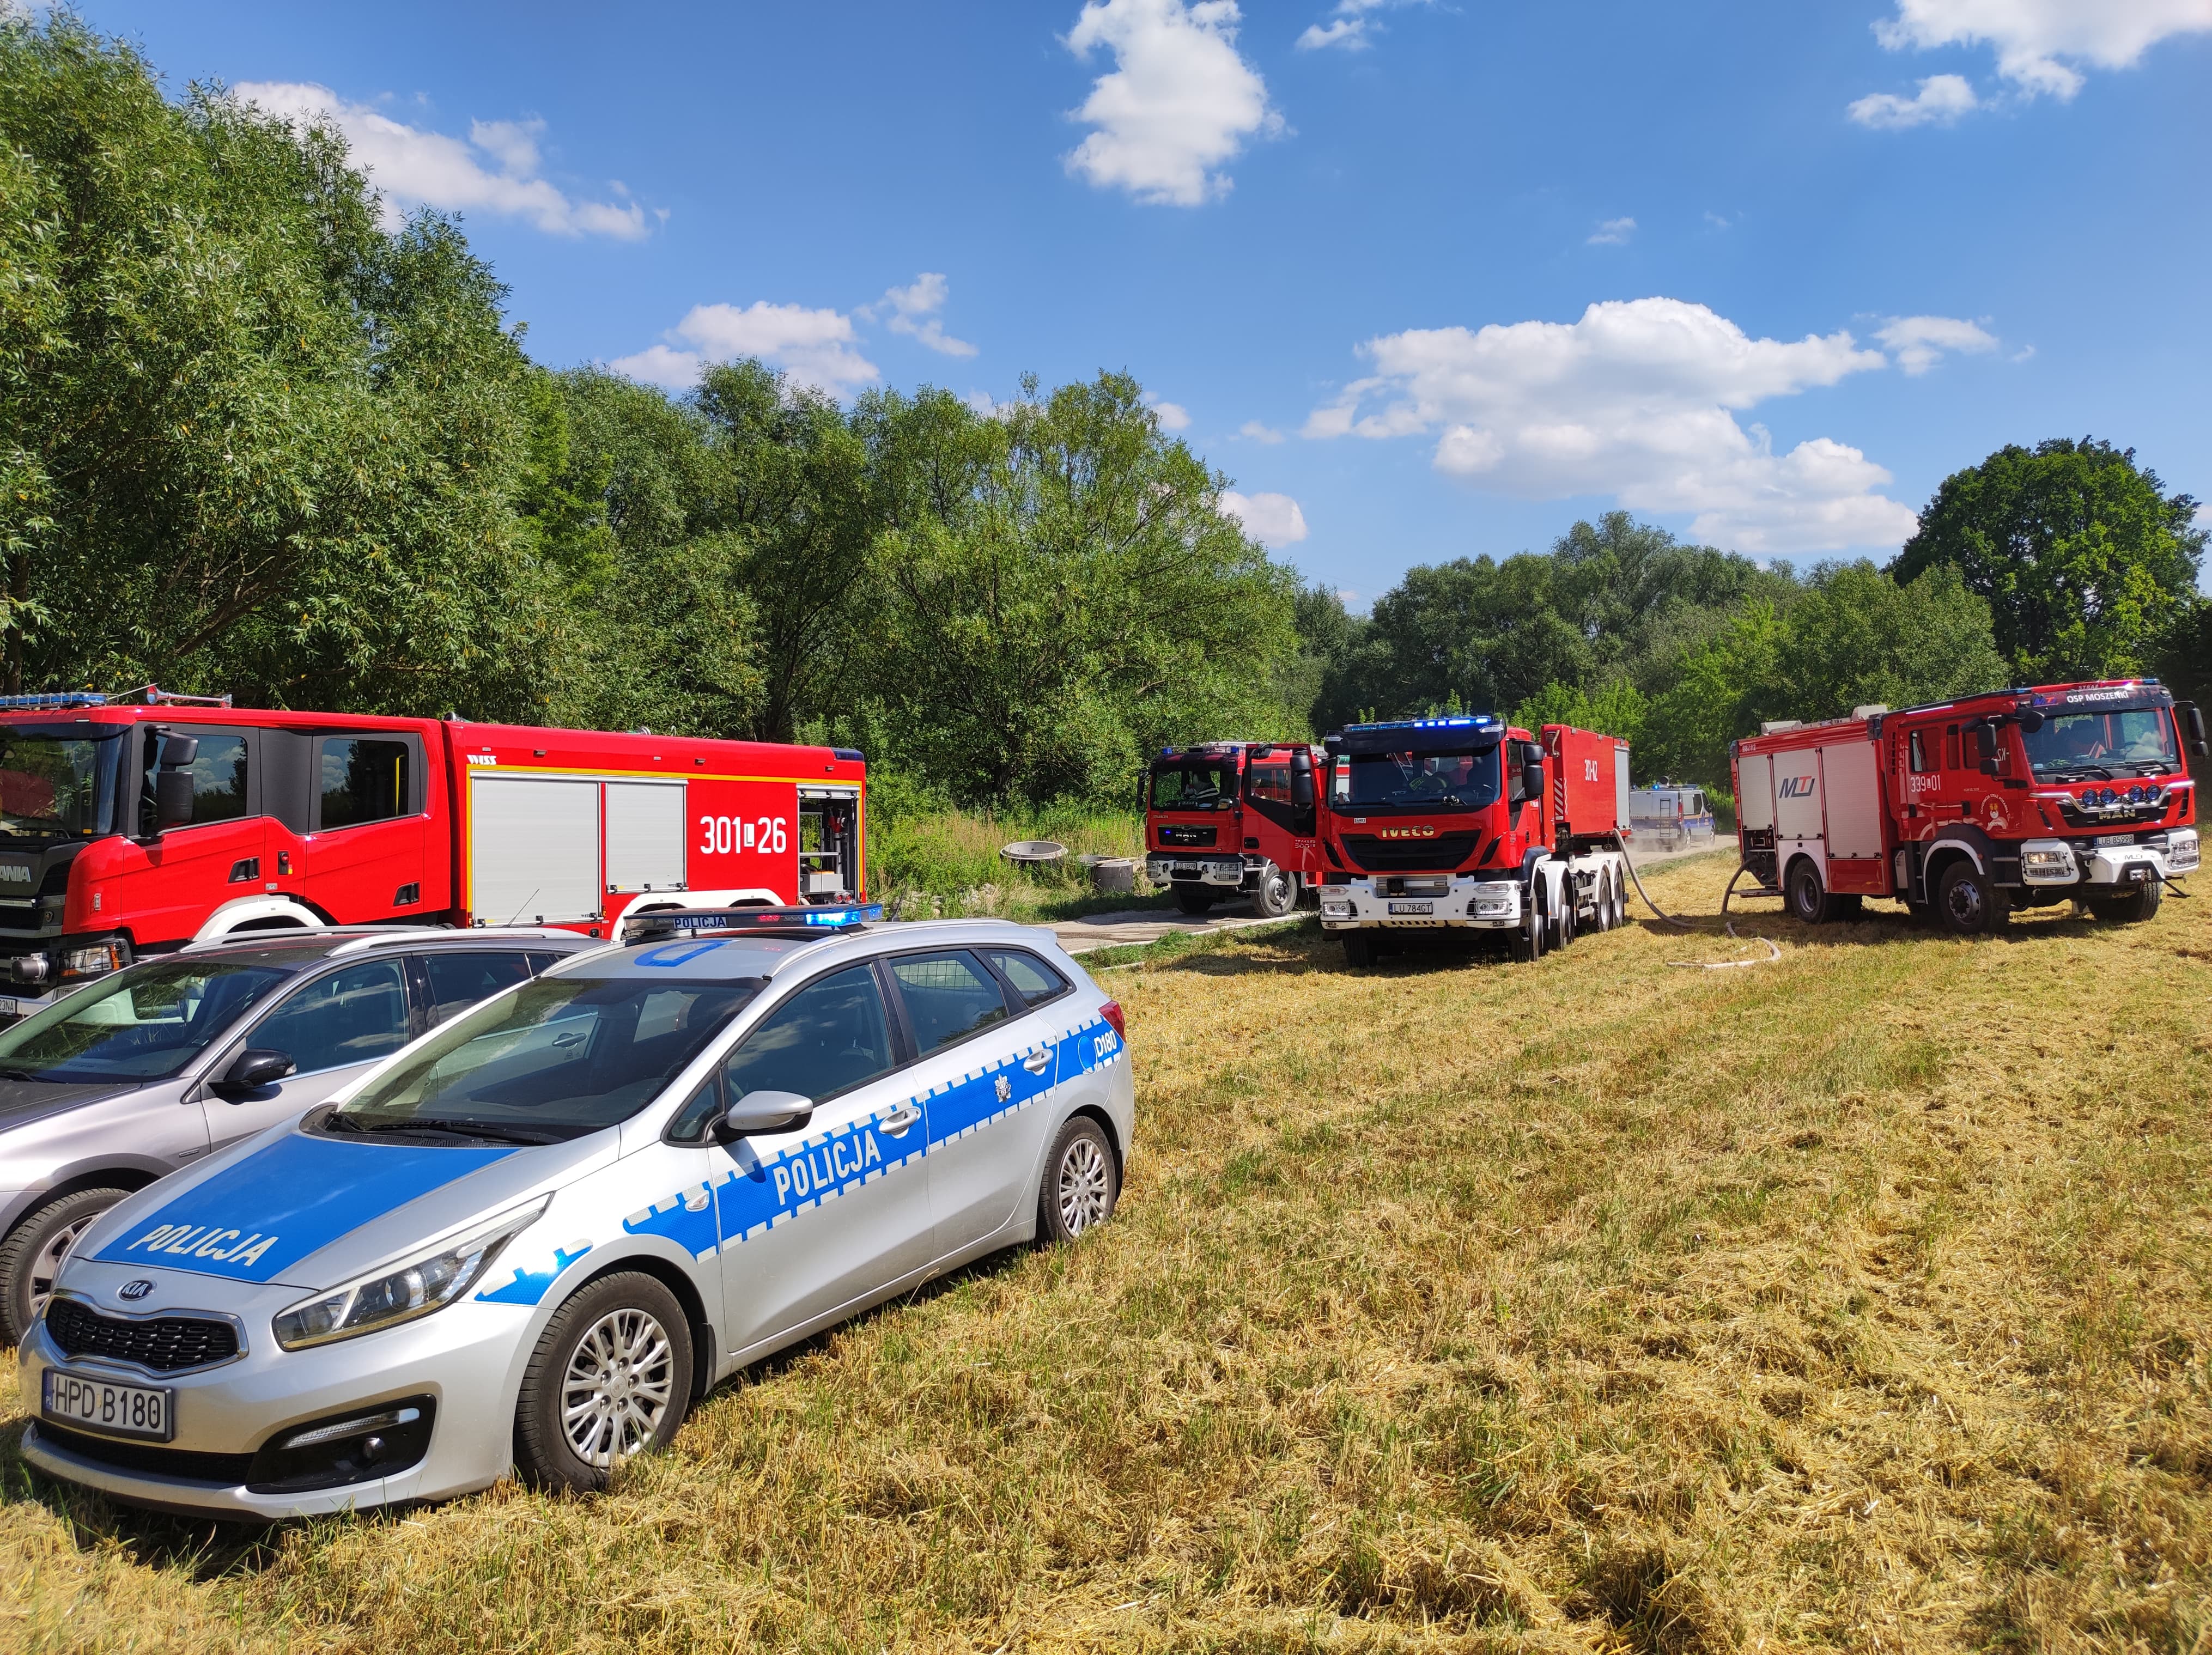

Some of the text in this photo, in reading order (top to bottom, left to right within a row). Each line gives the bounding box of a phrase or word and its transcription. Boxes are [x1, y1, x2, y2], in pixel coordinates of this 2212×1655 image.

[2085, 690, 2129, 701] MOSZENKI
[466, 754, 497, 765] WISS
[1584, 759, 1598, 782] 301-K2
[2099, 809, 2136, 820] MAN
[1382, 825, 1434, 837] IVECO
[2097, 837, 2111, 845] LUB
[2113, 836, 2133, 844] 85998
[674, 917, 726, 928] POLICJA
[1093, 1030, 1117, 1058] D180
[773, 1129, 882, 1206] POLICJA
[126, 1224, 279, 1267] POLICJA
[121, 1282, 149, 1297] KIA
[46, 1395, 52, 1405] PL
[56, 1377, 161, 1429] HPD B180
